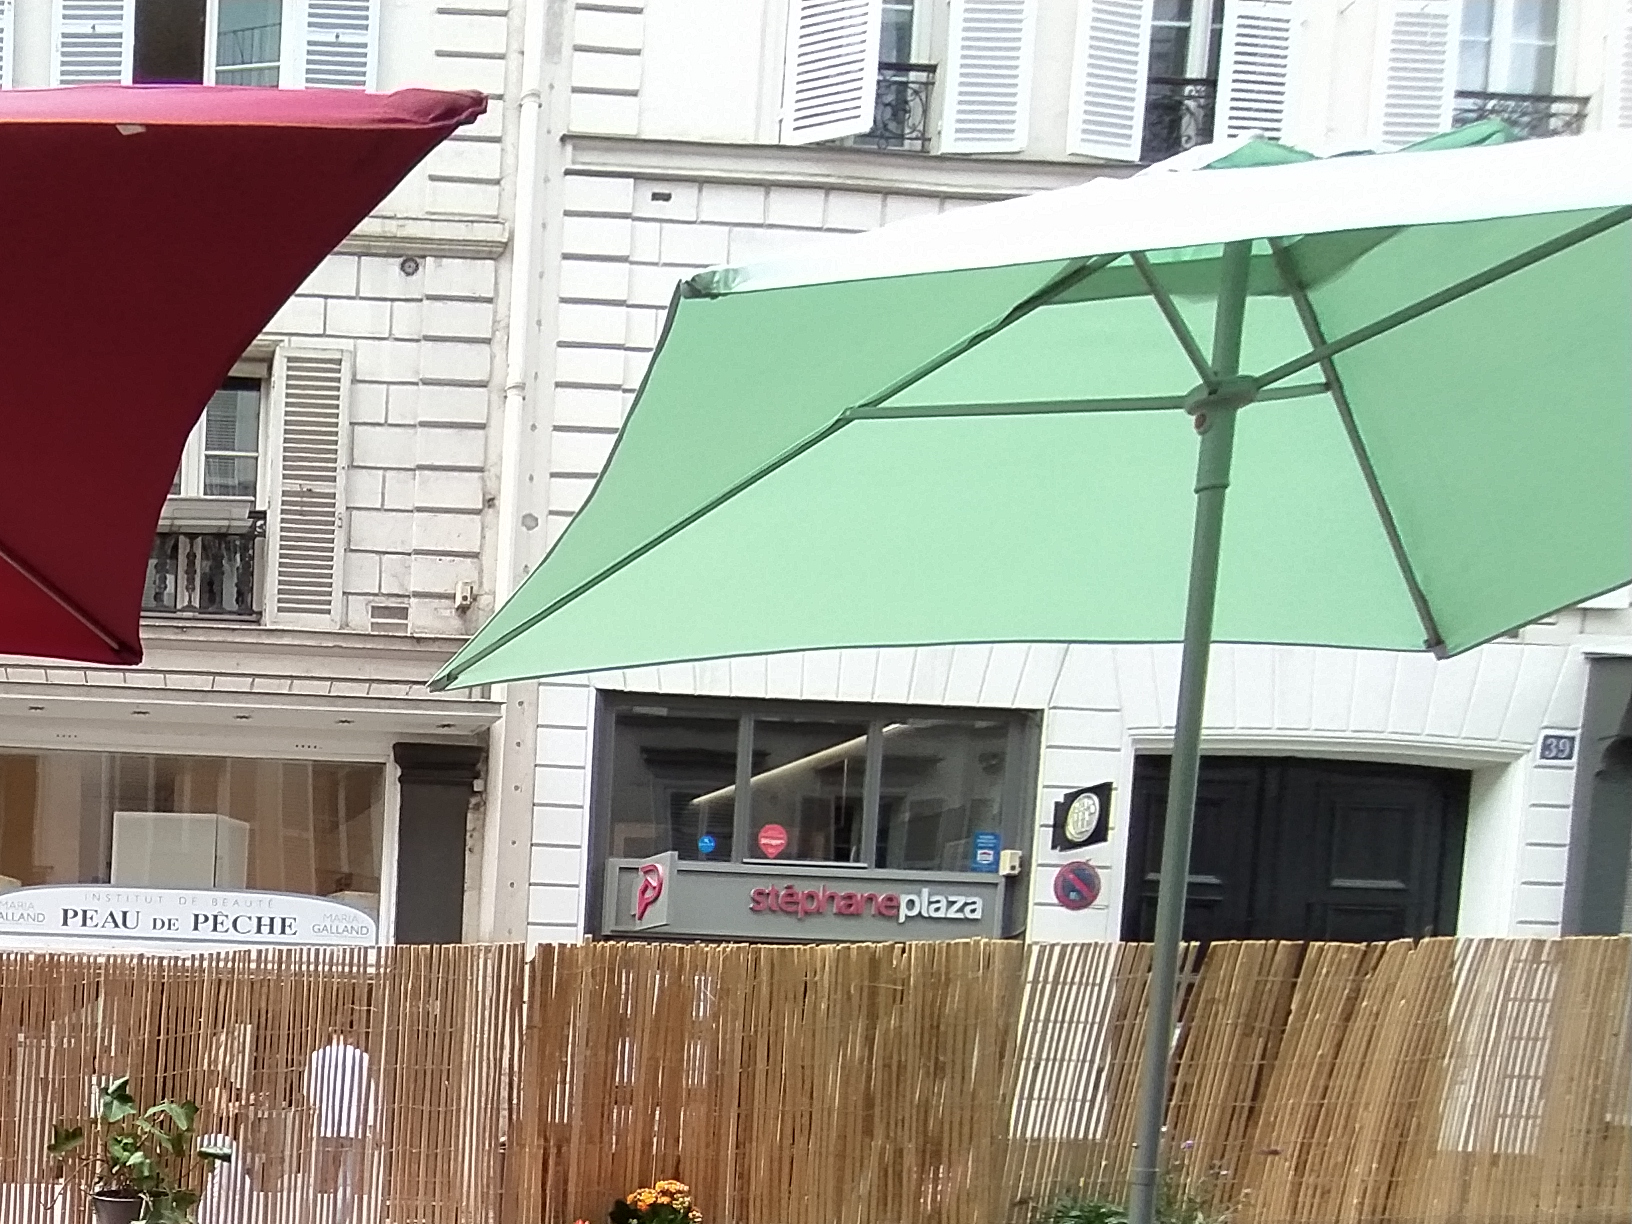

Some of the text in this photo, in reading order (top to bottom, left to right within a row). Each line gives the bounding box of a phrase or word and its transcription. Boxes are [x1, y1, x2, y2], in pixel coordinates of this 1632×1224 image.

[1544, 738, 1570, 758] 39
[84, 893, 274, 909] INSTITUT DE BEAUTÉ
[749, 884, 983, 923] stéphaneplaza
[60, 908, 298, 936] PEAU DE PÊCHE
[322, 913, 360, 924] MARIA
[312, 923, 370, 936] GALLAND
